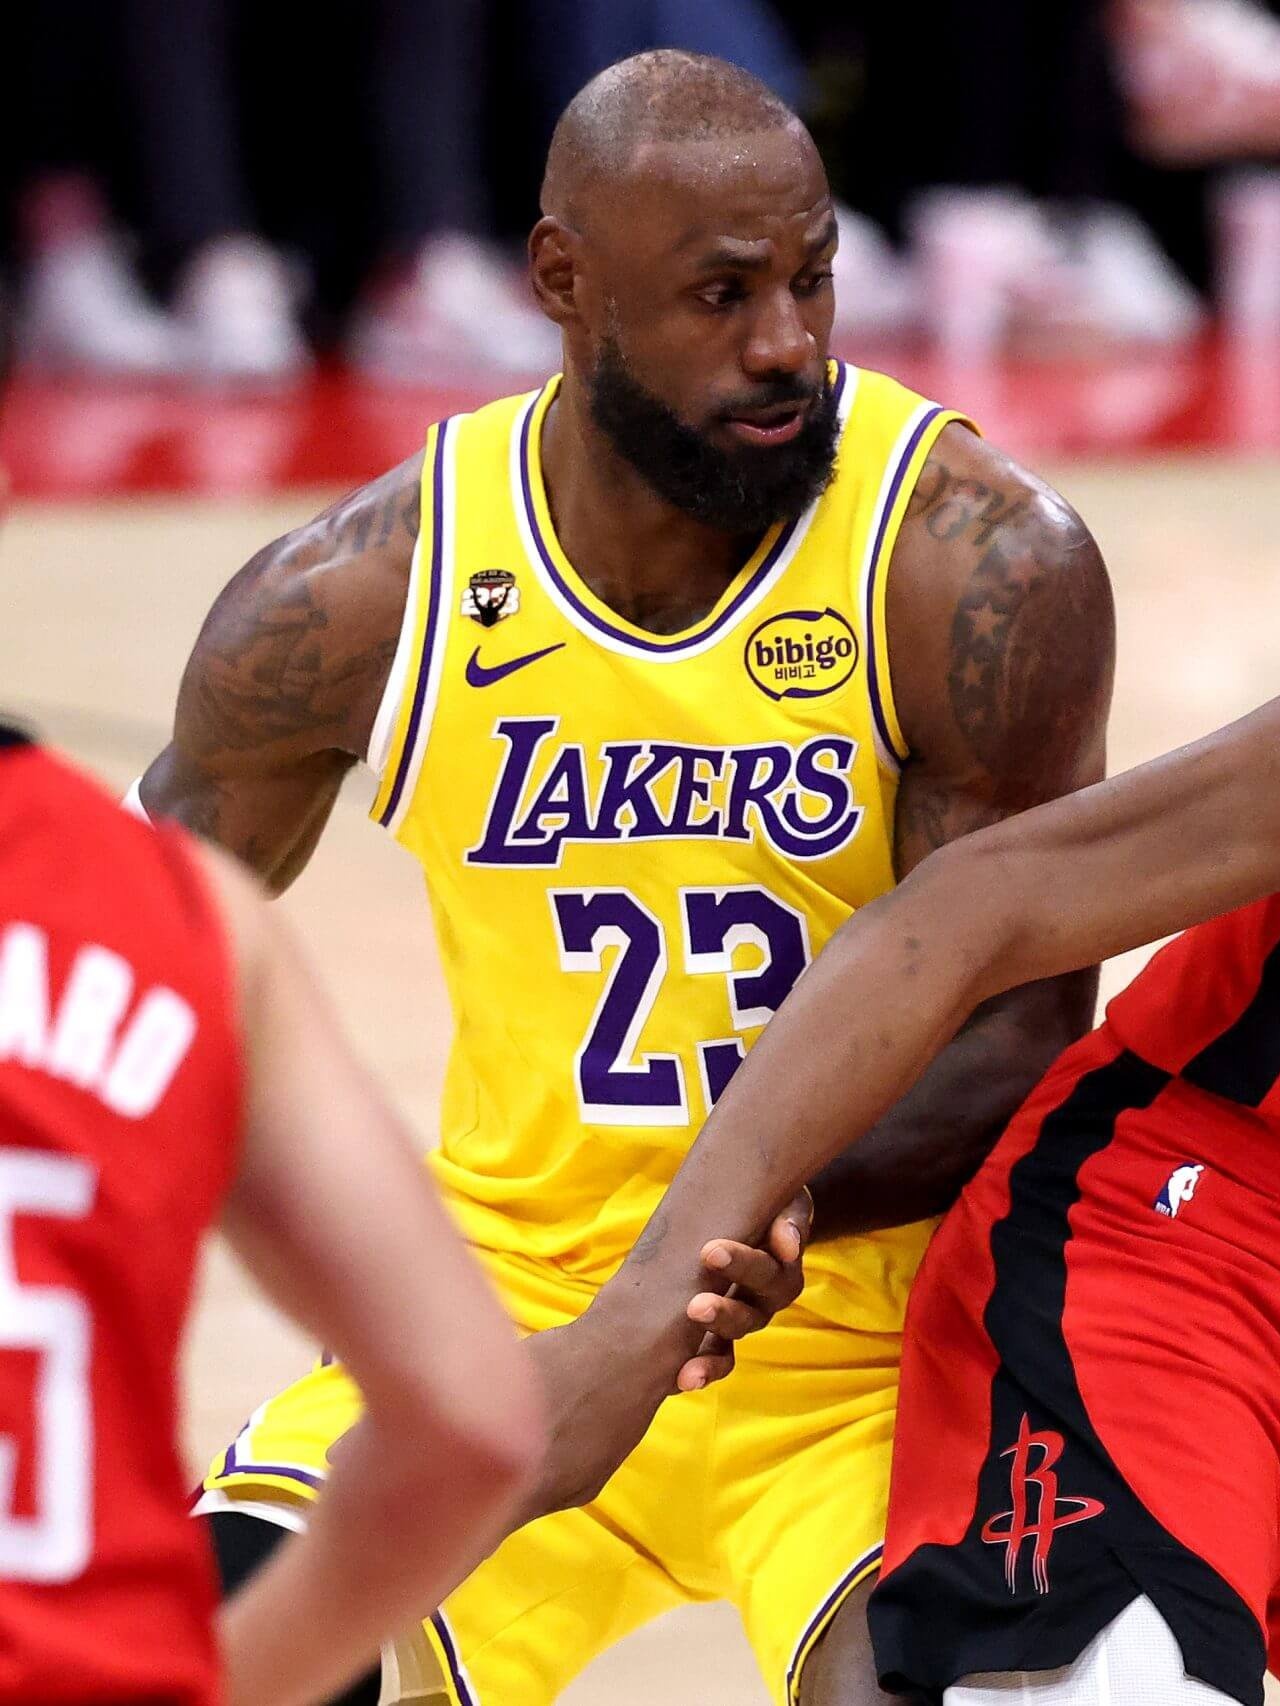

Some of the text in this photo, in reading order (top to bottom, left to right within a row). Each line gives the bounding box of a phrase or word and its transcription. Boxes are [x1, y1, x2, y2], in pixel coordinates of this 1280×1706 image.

[755, 633, 853, 670] bibigo
[774, 664, 816, 681] 비비고
[463, 715, 866, 868] LAKERS
[546, 884, 811, 1127] 23
